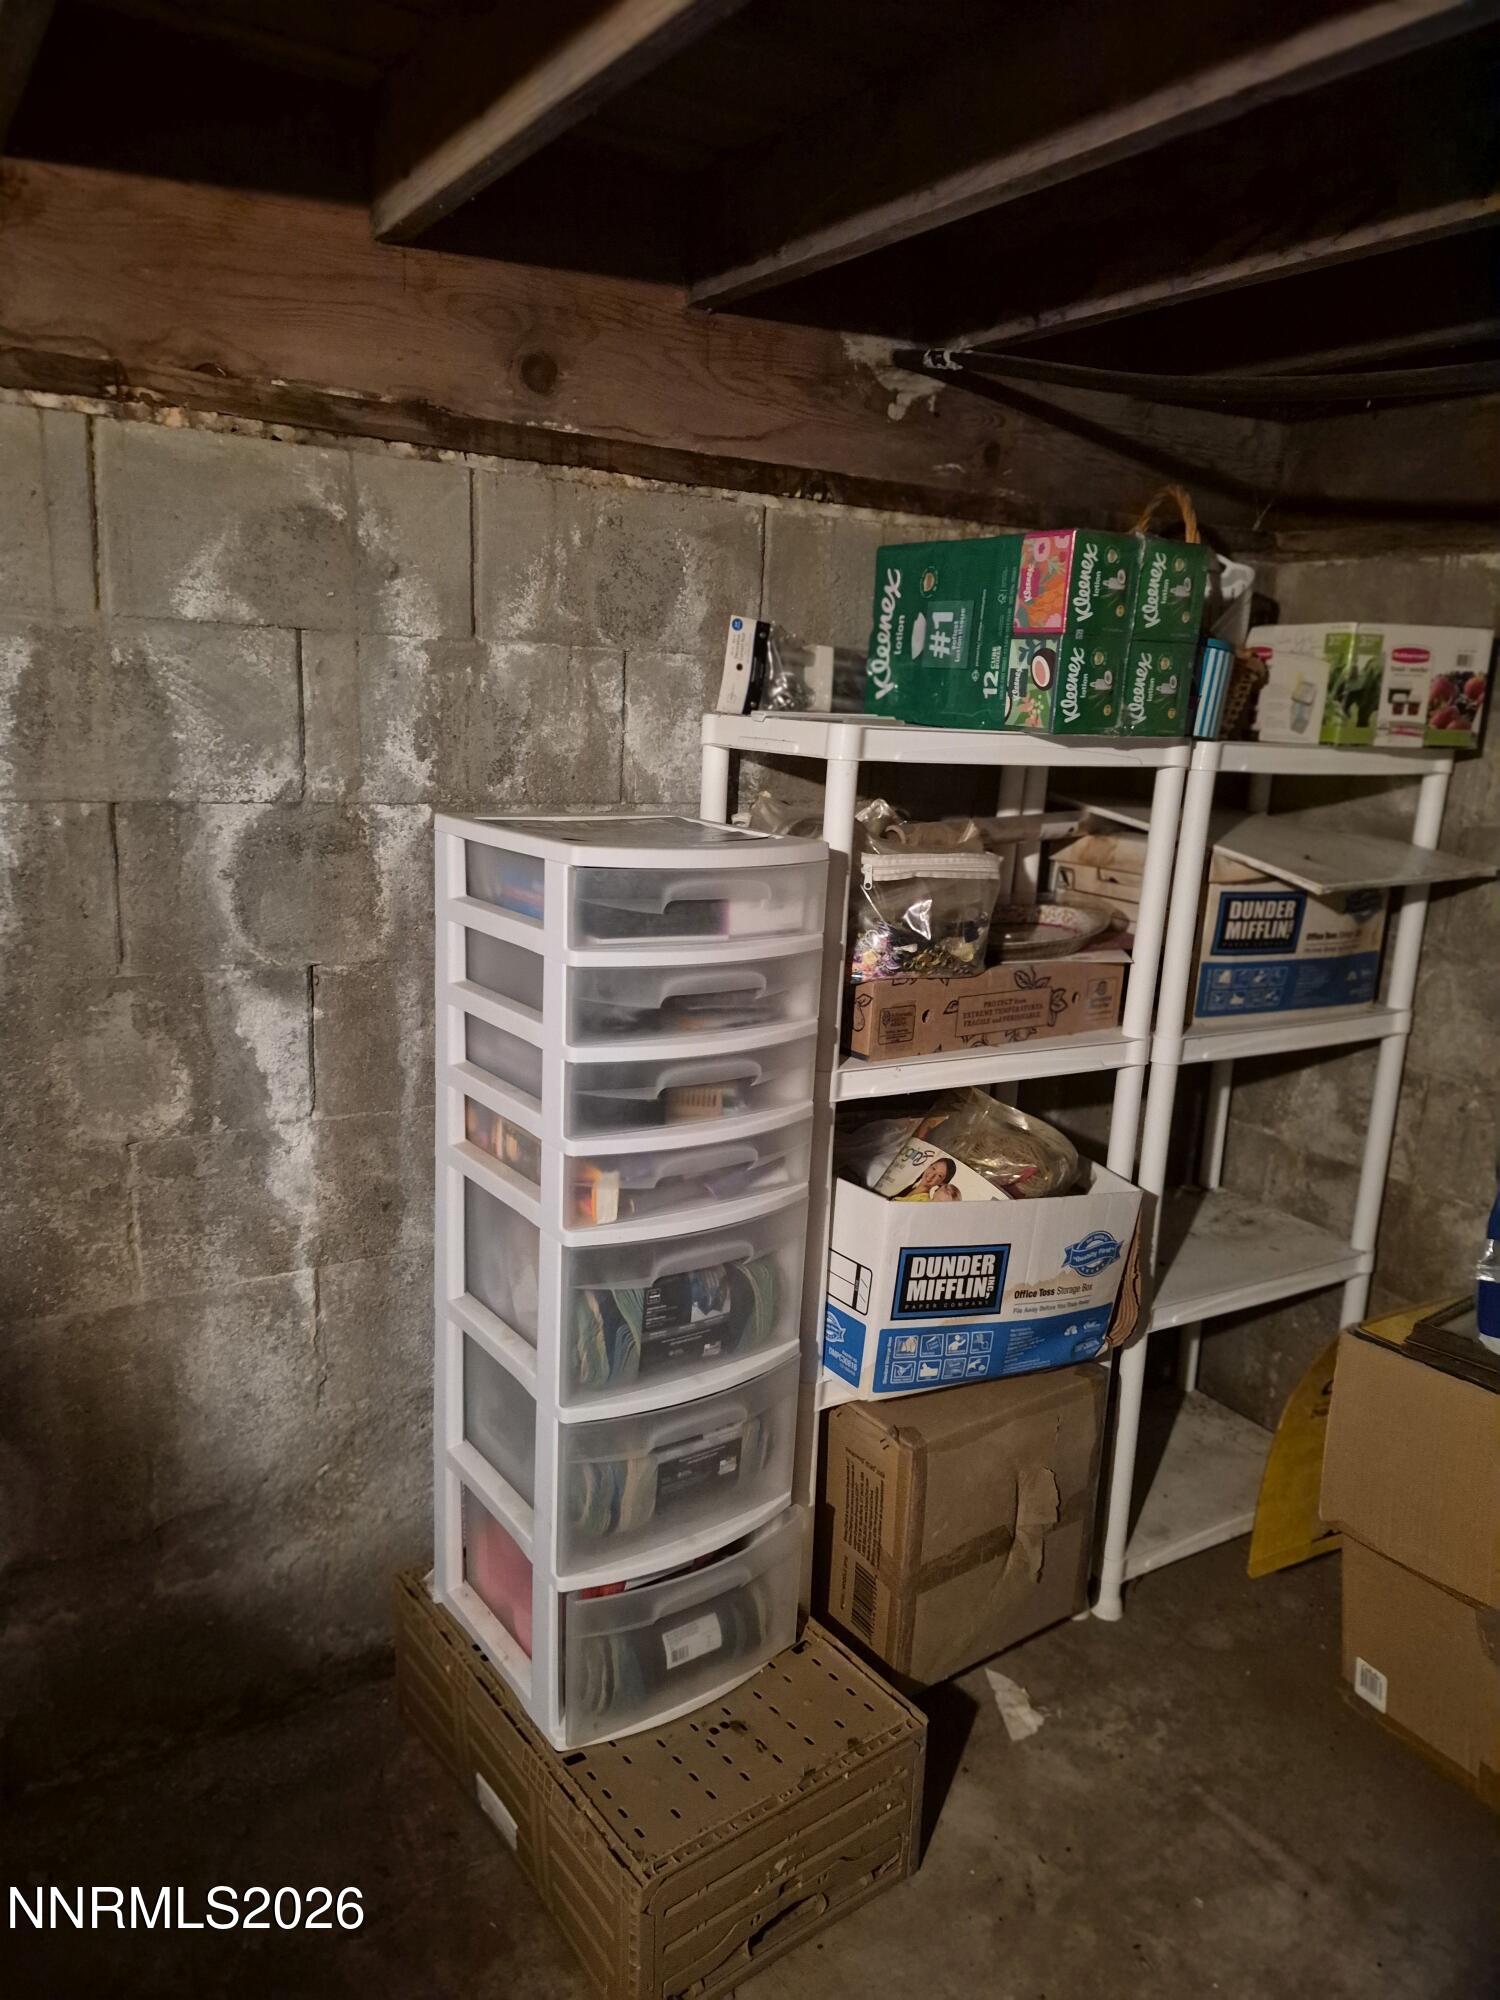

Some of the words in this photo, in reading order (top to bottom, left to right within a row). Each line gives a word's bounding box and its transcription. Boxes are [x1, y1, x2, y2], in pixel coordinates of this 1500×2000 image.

[1023, 563, 1036, 603] Kleenex
[1072, 543, 1099, 622] Kleenex
[1092, 570, 1102, 597] lotion
[1142, 552, 1167, 629] Kleenex
[867, 567, 902, 700] Kleenex
[928, 611, 954, 660] #1
[982, 670, 1000, 699] 12
[1010, 667, 1023, 702] Kleenex
[1060, 647, 1086, 723] Kleenex
[1080, 673, 1089, 699] lotion
[1127, 652, 1153, 725] Kleenex
[1228, 900, 1297, 919] DUNDER
[963, 1008, 993, 1019] EXTREME
[984, 998, 1013, 1008] PROTECT
[910, 1253, 996, 1279] DUNDER
[1014, 1289, 1037, 1299] Office
[1040, 1287, 1055, 1296] Toss
[1057, 1285, 1081, 1296] Storage
[1082, 1282, 1093, 1292] Box
[904, 1303, 938, 1311] PAPER
[943, 1300, 990, 1309] COMPANY
